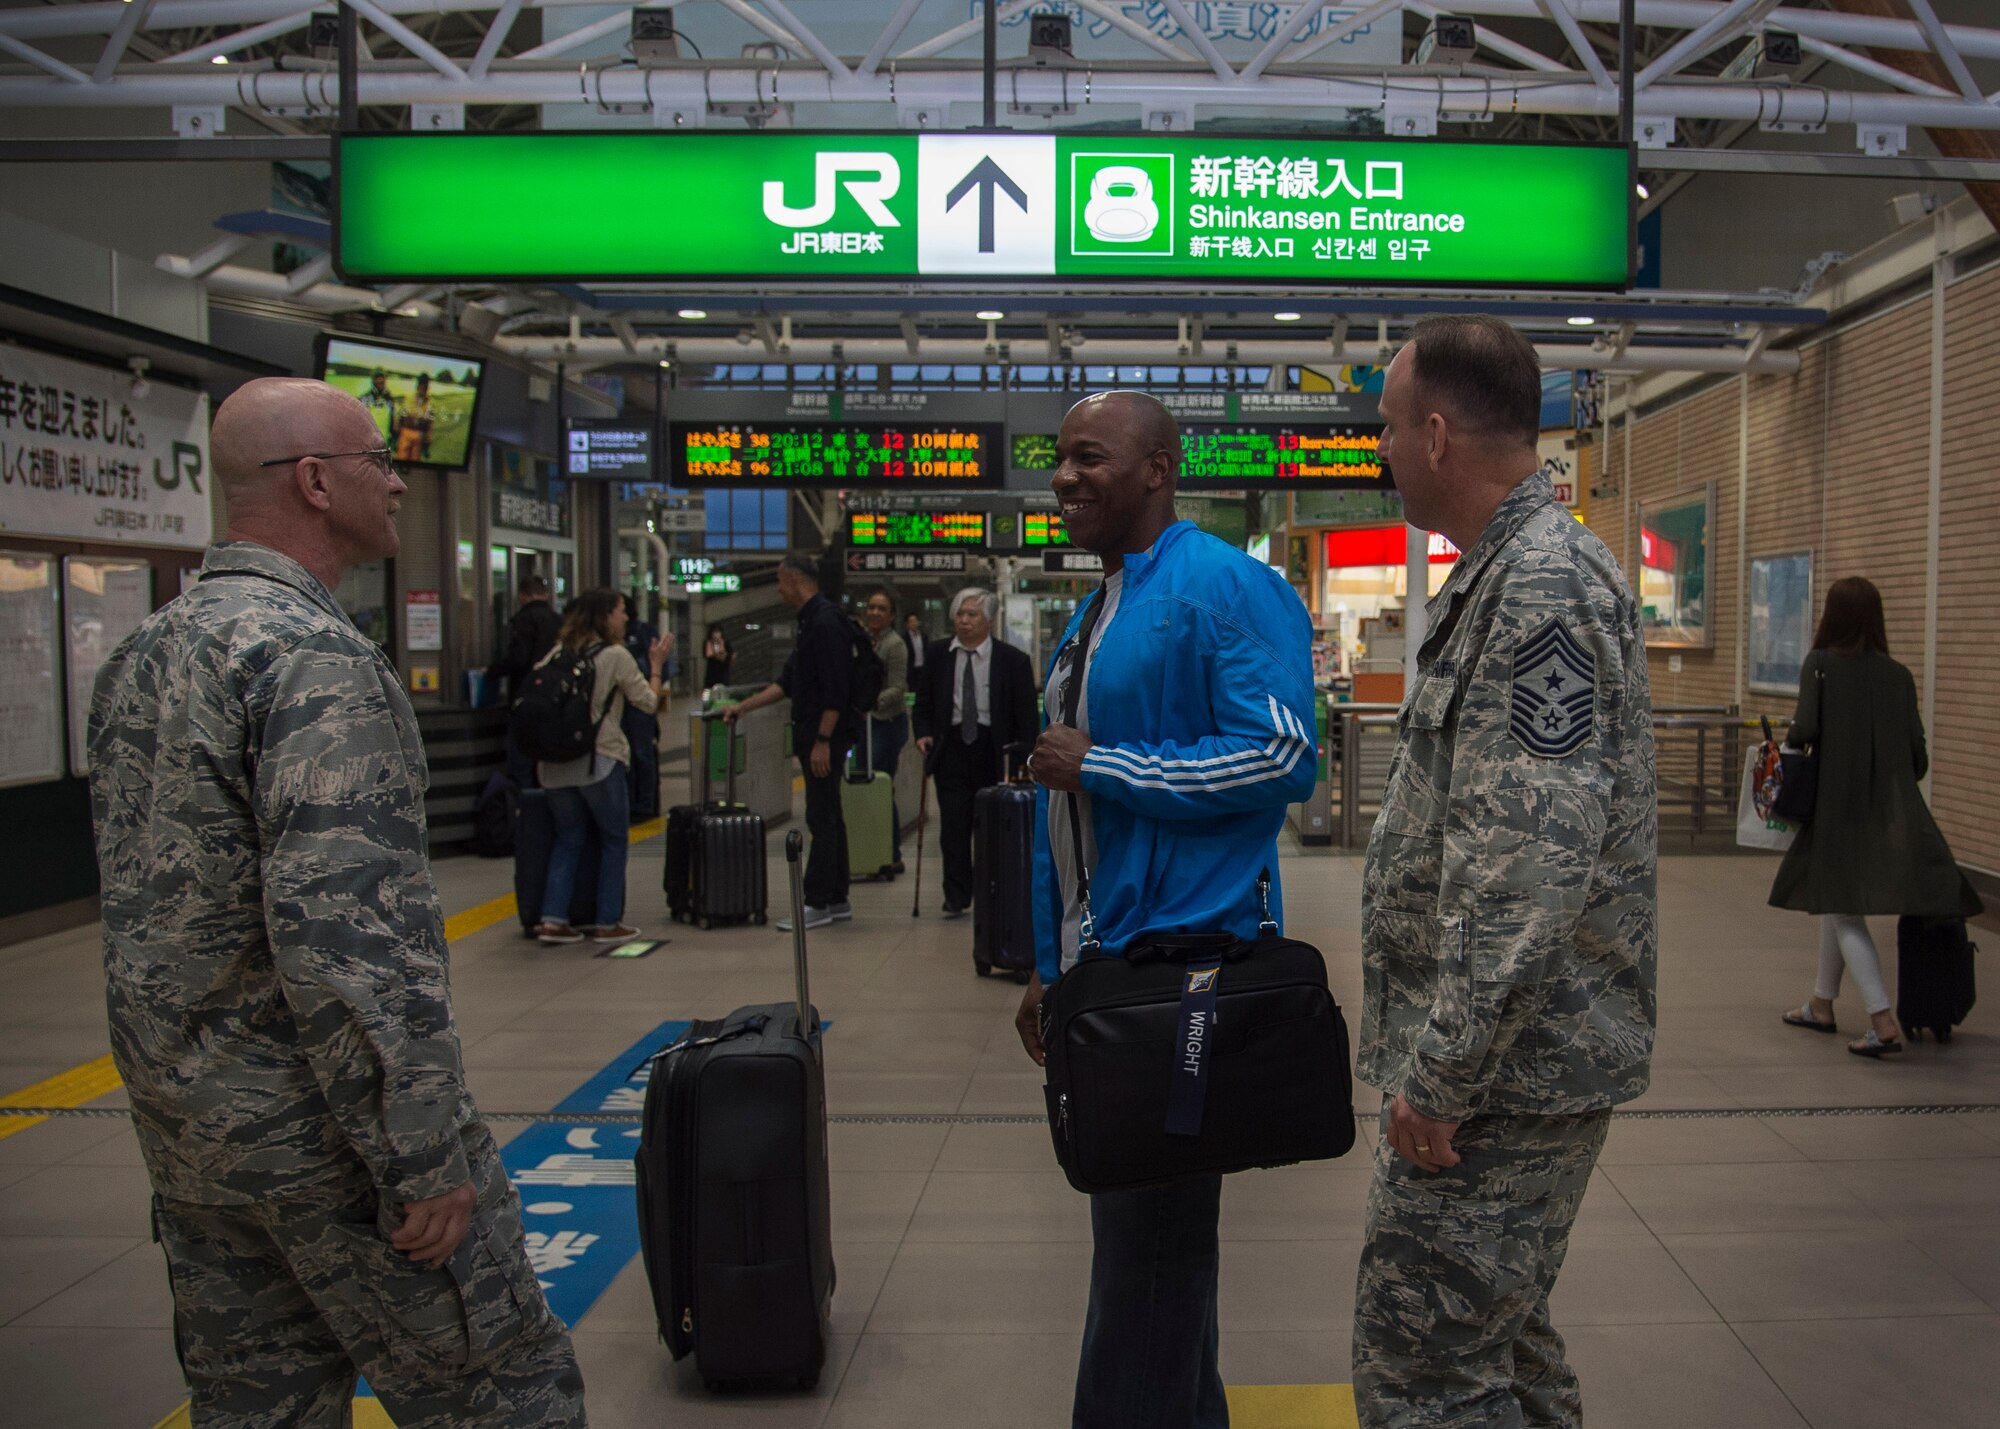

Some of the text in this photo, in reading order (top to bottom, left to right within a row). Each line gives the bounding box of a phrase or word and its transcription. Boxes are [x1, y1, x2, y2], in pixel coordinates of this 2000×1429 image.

[762, 151, 902, 228] JR
[1189, 156, 1403, 200] 新幹線入口
[1189, 204, 1465, 233] Shinkansen Entrance
[781, 231, 884, 253] JR東日本
[1189, 236, 1431, 261] 新干线入口 신칸센 입구
[1161, 393, 1225, 408] 海道新幹線
[0, 379, 145, 450] 年を迎えました。
[687, 432, 742, 448] はやぶさ
[750, 433, 769, 448] 38
[771, 433, 823, 448] 20:12
[883, 433, 904, 449] 12
[912, 433, 979, 449] 10両編成
[1278, 435, 1299, 450] 13
[1, 441, 147, 501] しくお願い申し上げます。
[153, 439, 202, 494] JR
[687, 461, 742, 476] はやぶさ
[750, 461, 770, 476] 96
[771, 461, 823, 476] 21:08
[883, 461, 904, 477] 12
[912, 461, 979, 477] 10両編成
[1278, 463, 1299, 477] 13
[1183, 1011, 1207, 1077] WRIGHT
